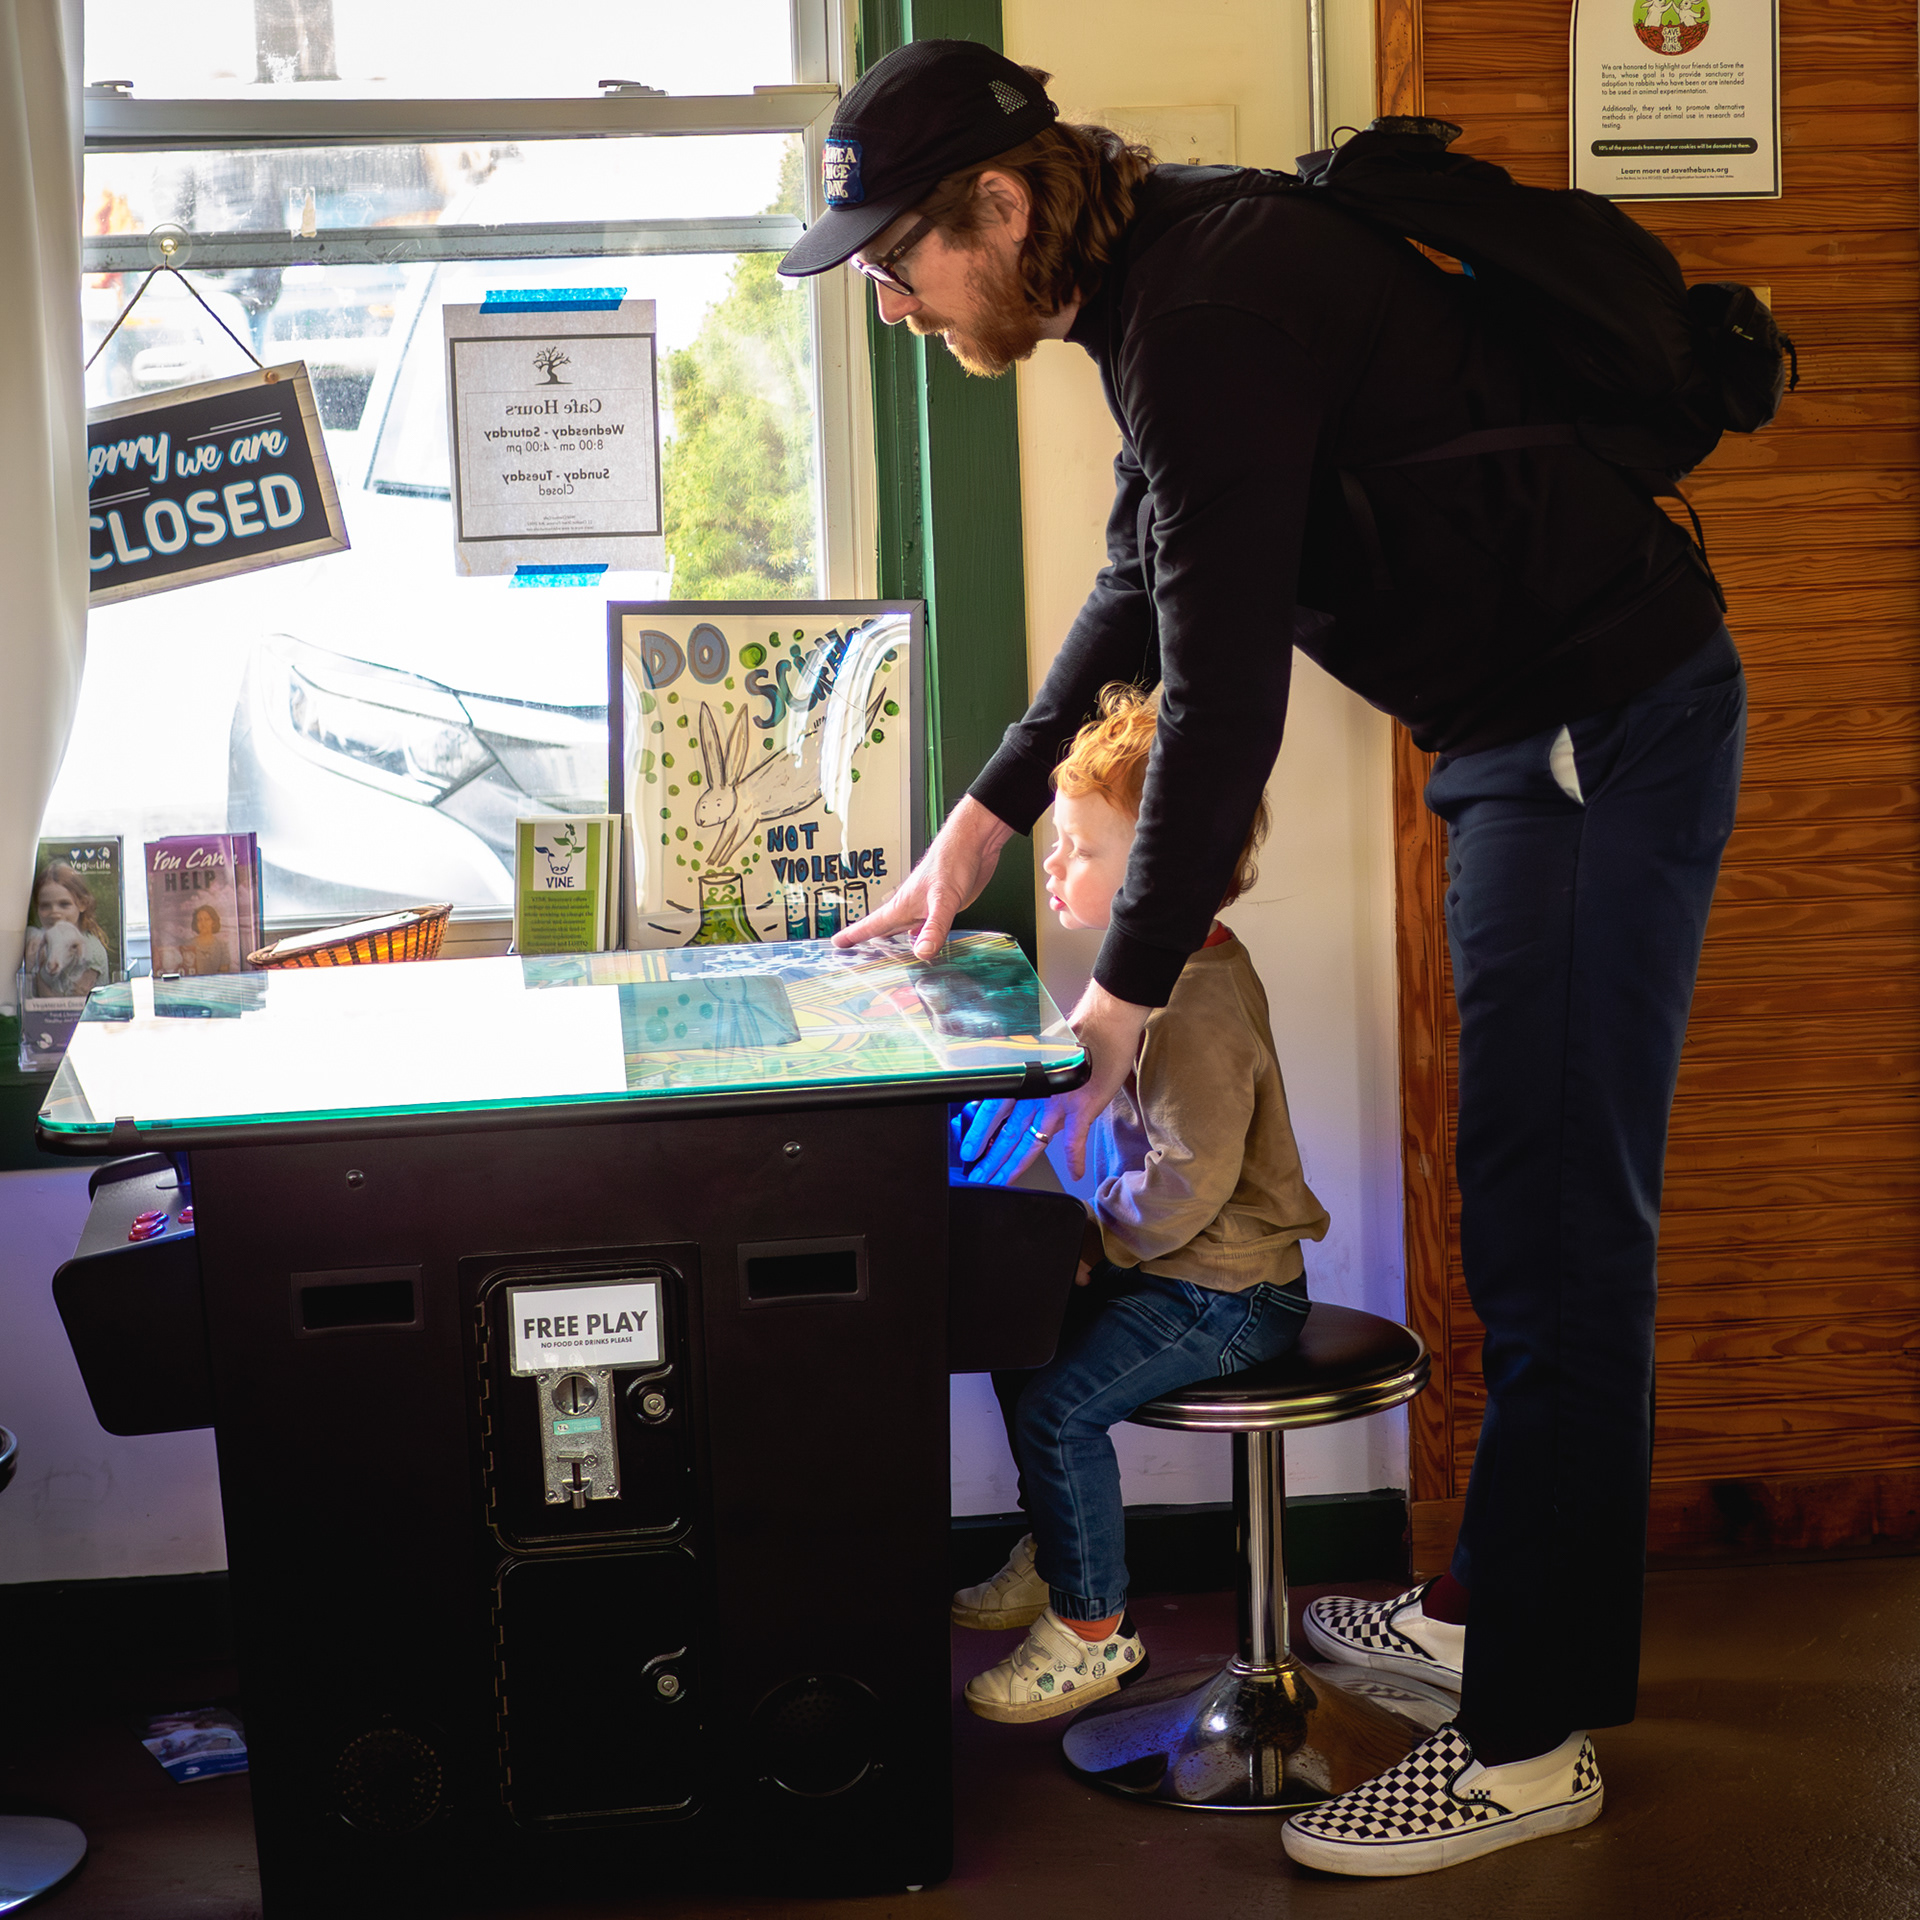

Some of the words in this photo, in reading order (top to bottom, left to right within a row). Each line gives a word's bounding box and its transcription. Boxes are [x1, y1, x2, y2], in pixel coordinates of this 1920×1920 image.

[1663, 28, 1679, 36] SAVE
[1655, 62, 1680, 71] highlight
[1643, 71, 1656, 80] goal
[1679, 71, 1701, 79] provide
[1602, 80, 1628, 88] adoption
[1602, 104, 1638, 113] Additionally,
[1642, 104, 1654, 113] they
[1686, 104, 1710, 112] promote
[1636, 113, 1653, 121] place
[844, 147, 857, 163] A
[1671, 166, 1728, 174] savethebuns.org
[88, 433, 170, 487] orry
[175, 445, 223, 478] we
[229, 430, 288, 464] are
[640, 623, 730, 690] DO
[768, 822, 819, 852] NOT
[153, 850, 181, 871] You
[186, 848, 225, 869] Can
[771, 848, 887, 883] VIOLENCE
[165, 870, 216, 892] HELP
[546, 876, 574, 888] VINE
[524, 1315, 579, 1339] FREE
[586, 1311, 648, 1335] PLAY
[585, 1338, 609, 1346] DRINKS
[611, 1336, 632, 1344] PLEASE
